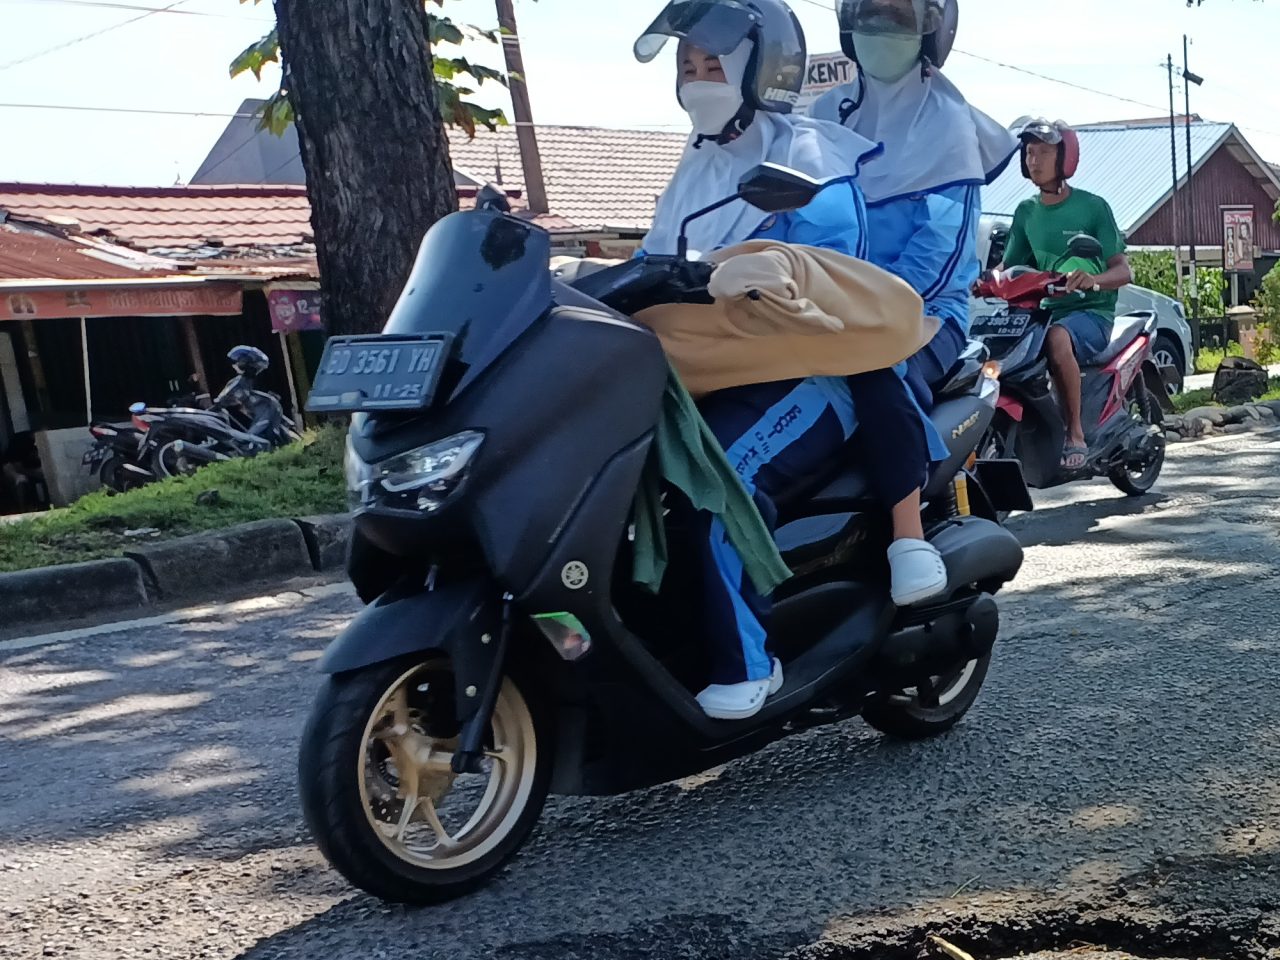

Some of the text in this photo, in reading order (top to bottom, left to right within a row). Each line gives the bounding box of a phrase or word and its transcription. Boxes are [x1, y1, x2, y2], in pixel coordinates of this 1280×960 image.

[807, 61, 850, 84] KENT
[352, 349, 400, 374] 3561
[407, 348, 435, 373] YH
